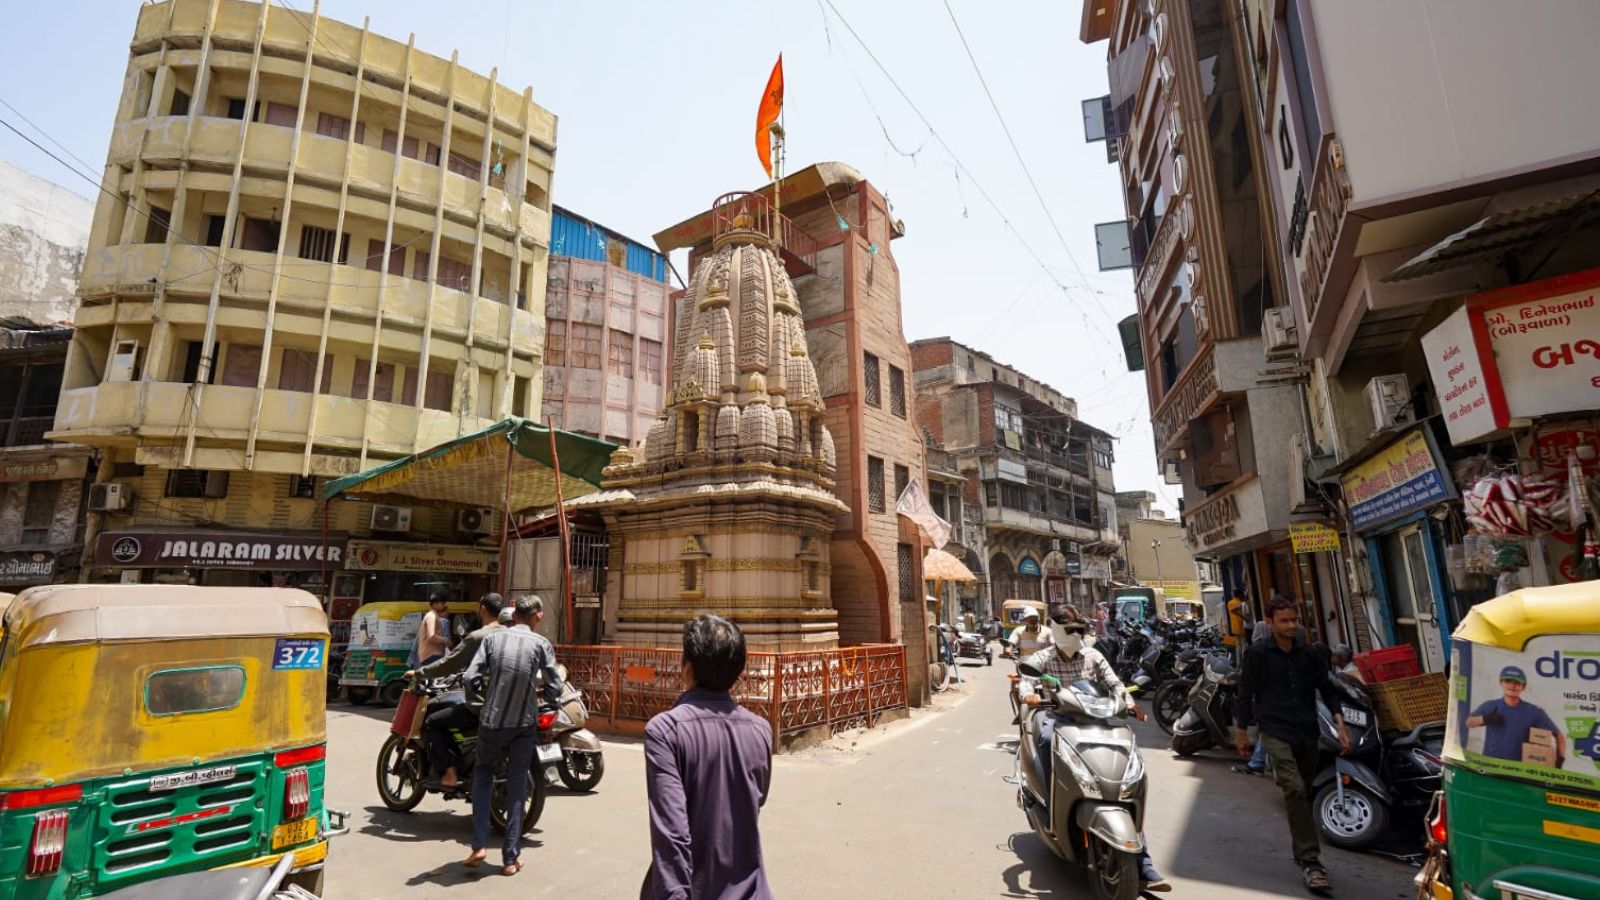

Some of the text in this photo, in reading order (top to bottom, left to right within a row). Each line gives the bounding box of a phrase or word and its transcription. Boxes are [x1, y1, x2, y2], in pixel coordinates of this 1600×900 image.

[1519, 295, 1595, 320] દિનેશભાઈ
[160, 540, 343, 562] JALARAM SILVER
[410, 556, 435, 566] Silver
[436, 557, 484, 568] Ornaments
[279, 646, 320, 665] 372
[1534, 650, 1600, 681] dro
